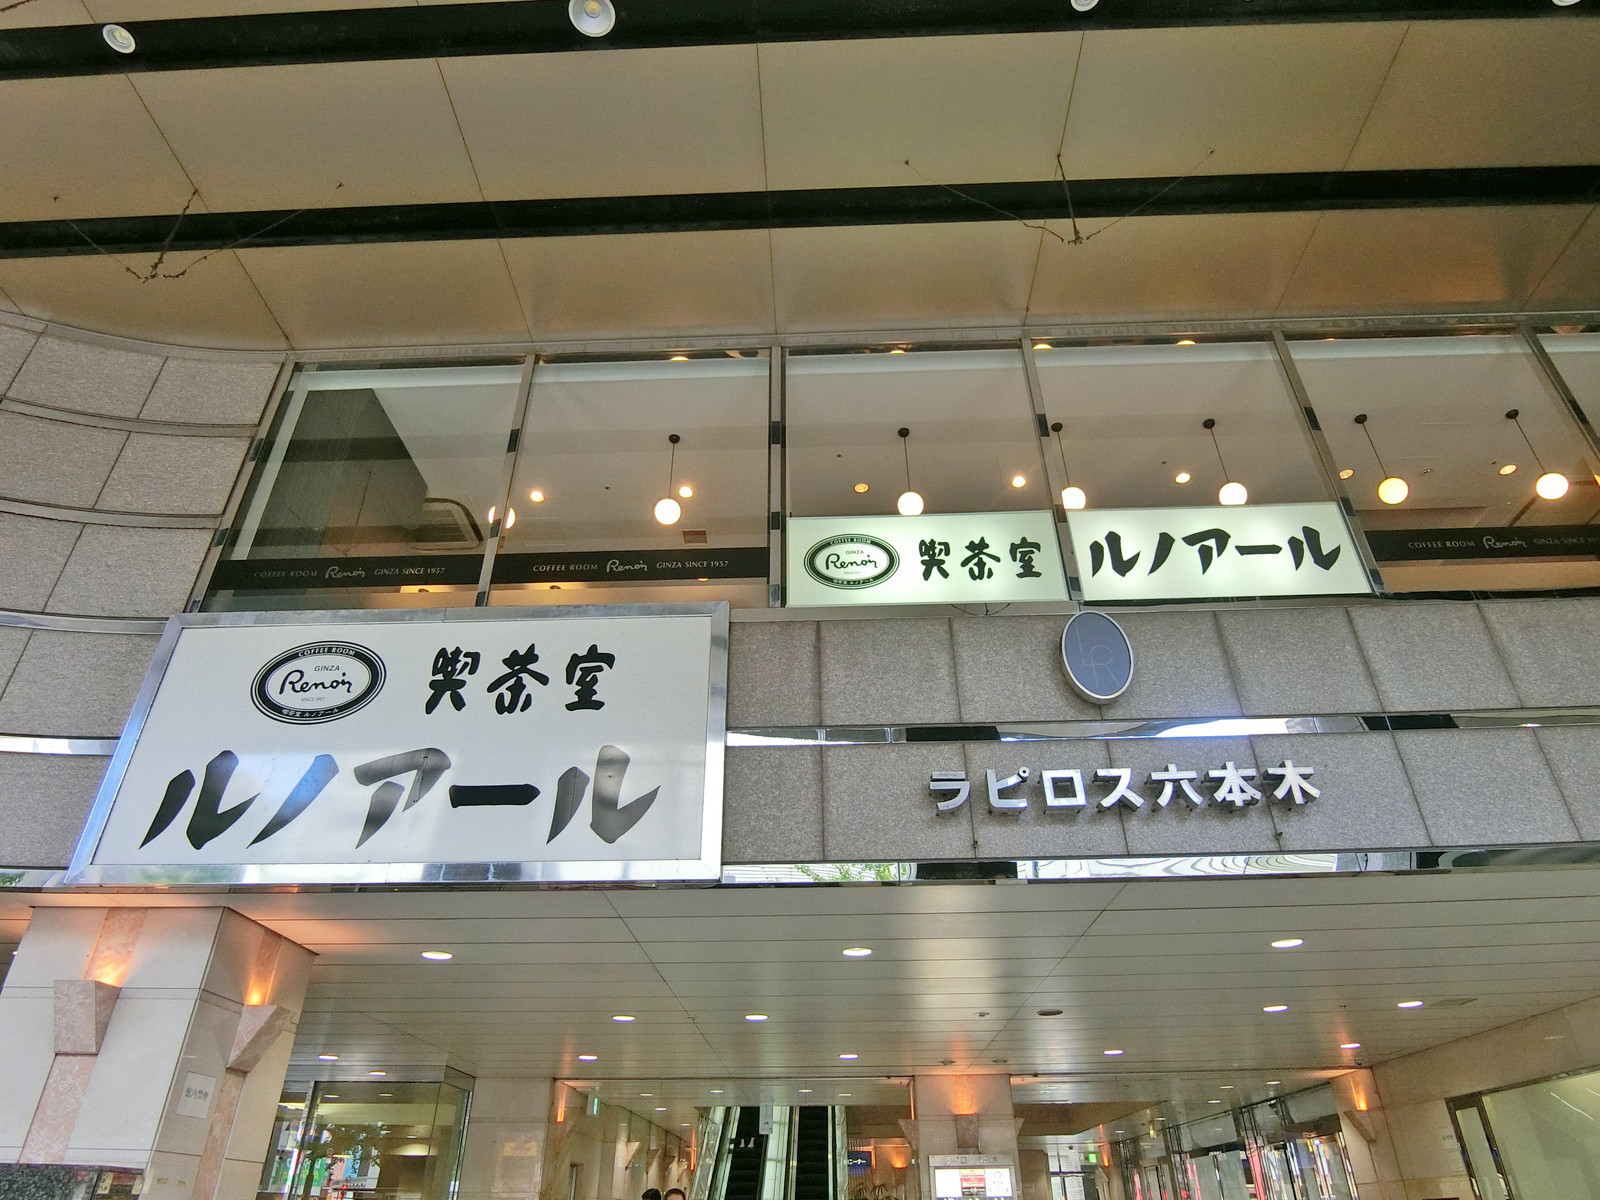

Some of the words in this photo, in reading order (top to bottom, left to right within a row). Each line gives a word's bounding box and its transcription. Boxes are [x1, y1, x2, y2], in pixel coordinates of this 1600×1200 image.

[1088, 525, 1341, 578] ルノアール
[1408, 540, 1442, 549] COFFEE
[1445, 540, 1475, 548] ROOM
[1482, 535, 1527, 550] Renoir
[533, 563, 566, 572] COFFEE
[569, 563, 598, 571] ROOM
[606, 559, 648, 573] Renoir
[656, 561, 682, 569] GINZA
[710, 560, 729, 568] 1957
[825, 553, 878, 570] Renoir
[918, 536, 1043, 581] 喫茶室
[254, 570, 286, 578] COFFEE
[289, 569, 319, 577] ROOM
[324, 566, 365, 579] Renoir
[374, 568, 399, 576] GINZA
[402, 567, 425, 575] SINCE
[298, 646, 328, 657] COFFEE
[331, 647, 356, 656] ROOM
[279, 669, 352, 695] Renoir
[425, 643, 616, 715] 喫茶室
[138, 744, 662, 851] ルノアール
[928, 759, 1322, 812] ラピロス六本木
